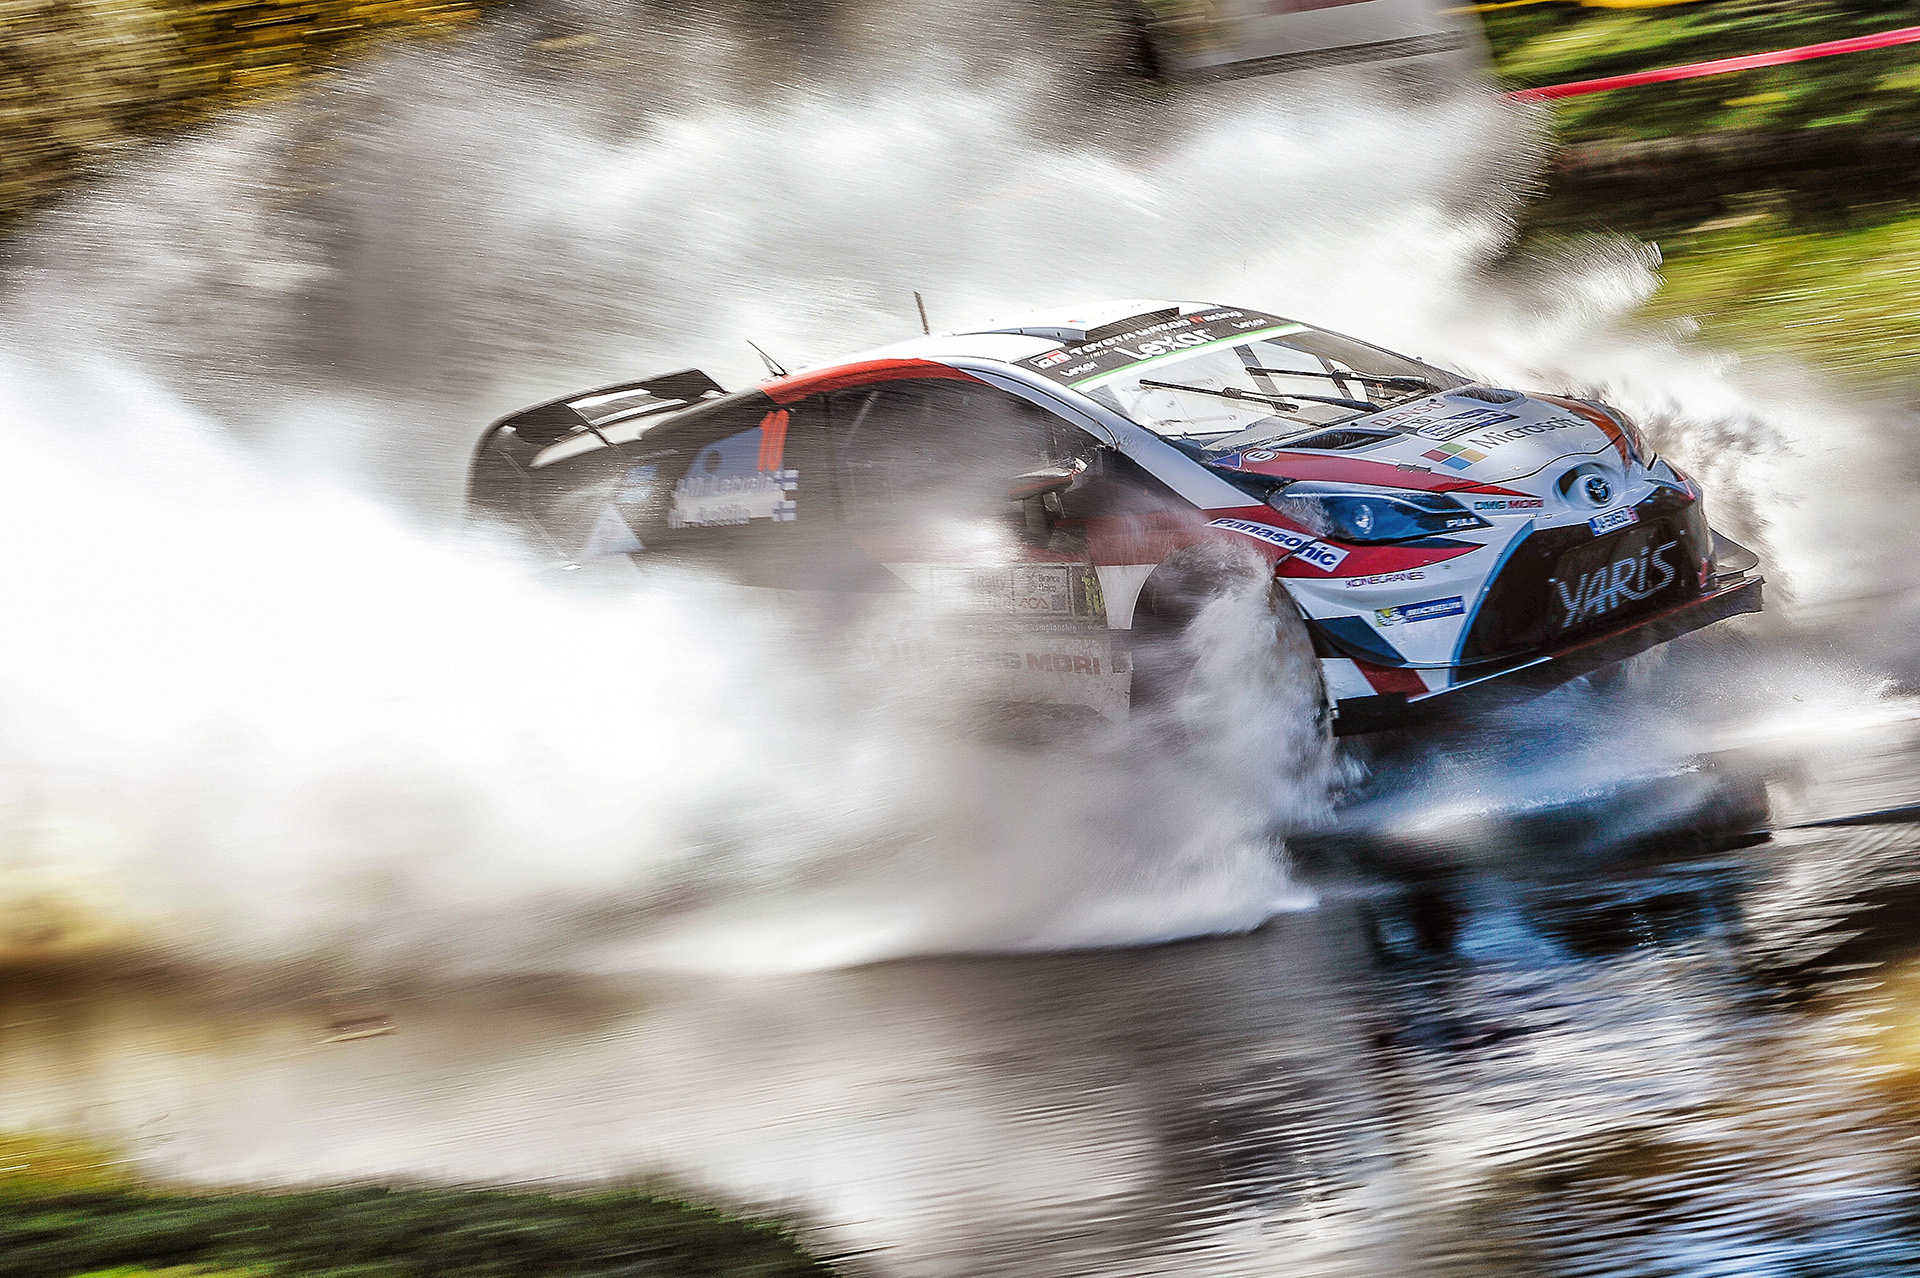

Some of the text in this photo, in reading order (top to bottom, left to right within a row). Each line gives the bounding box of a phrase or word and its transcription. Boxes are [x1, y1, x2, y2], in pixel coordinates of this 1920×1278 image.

[1068, 332, 1137, 356] TOYOTA
[1113, 329, 1217, 360] Lexar
[1371, 402, 1446, 428] DENSO
[1468, 415, 1586, 449] Microsoft
[1211, 518, 1338, 566] Panasonic
[1345, 571, 1426, 588] KONECRANES
